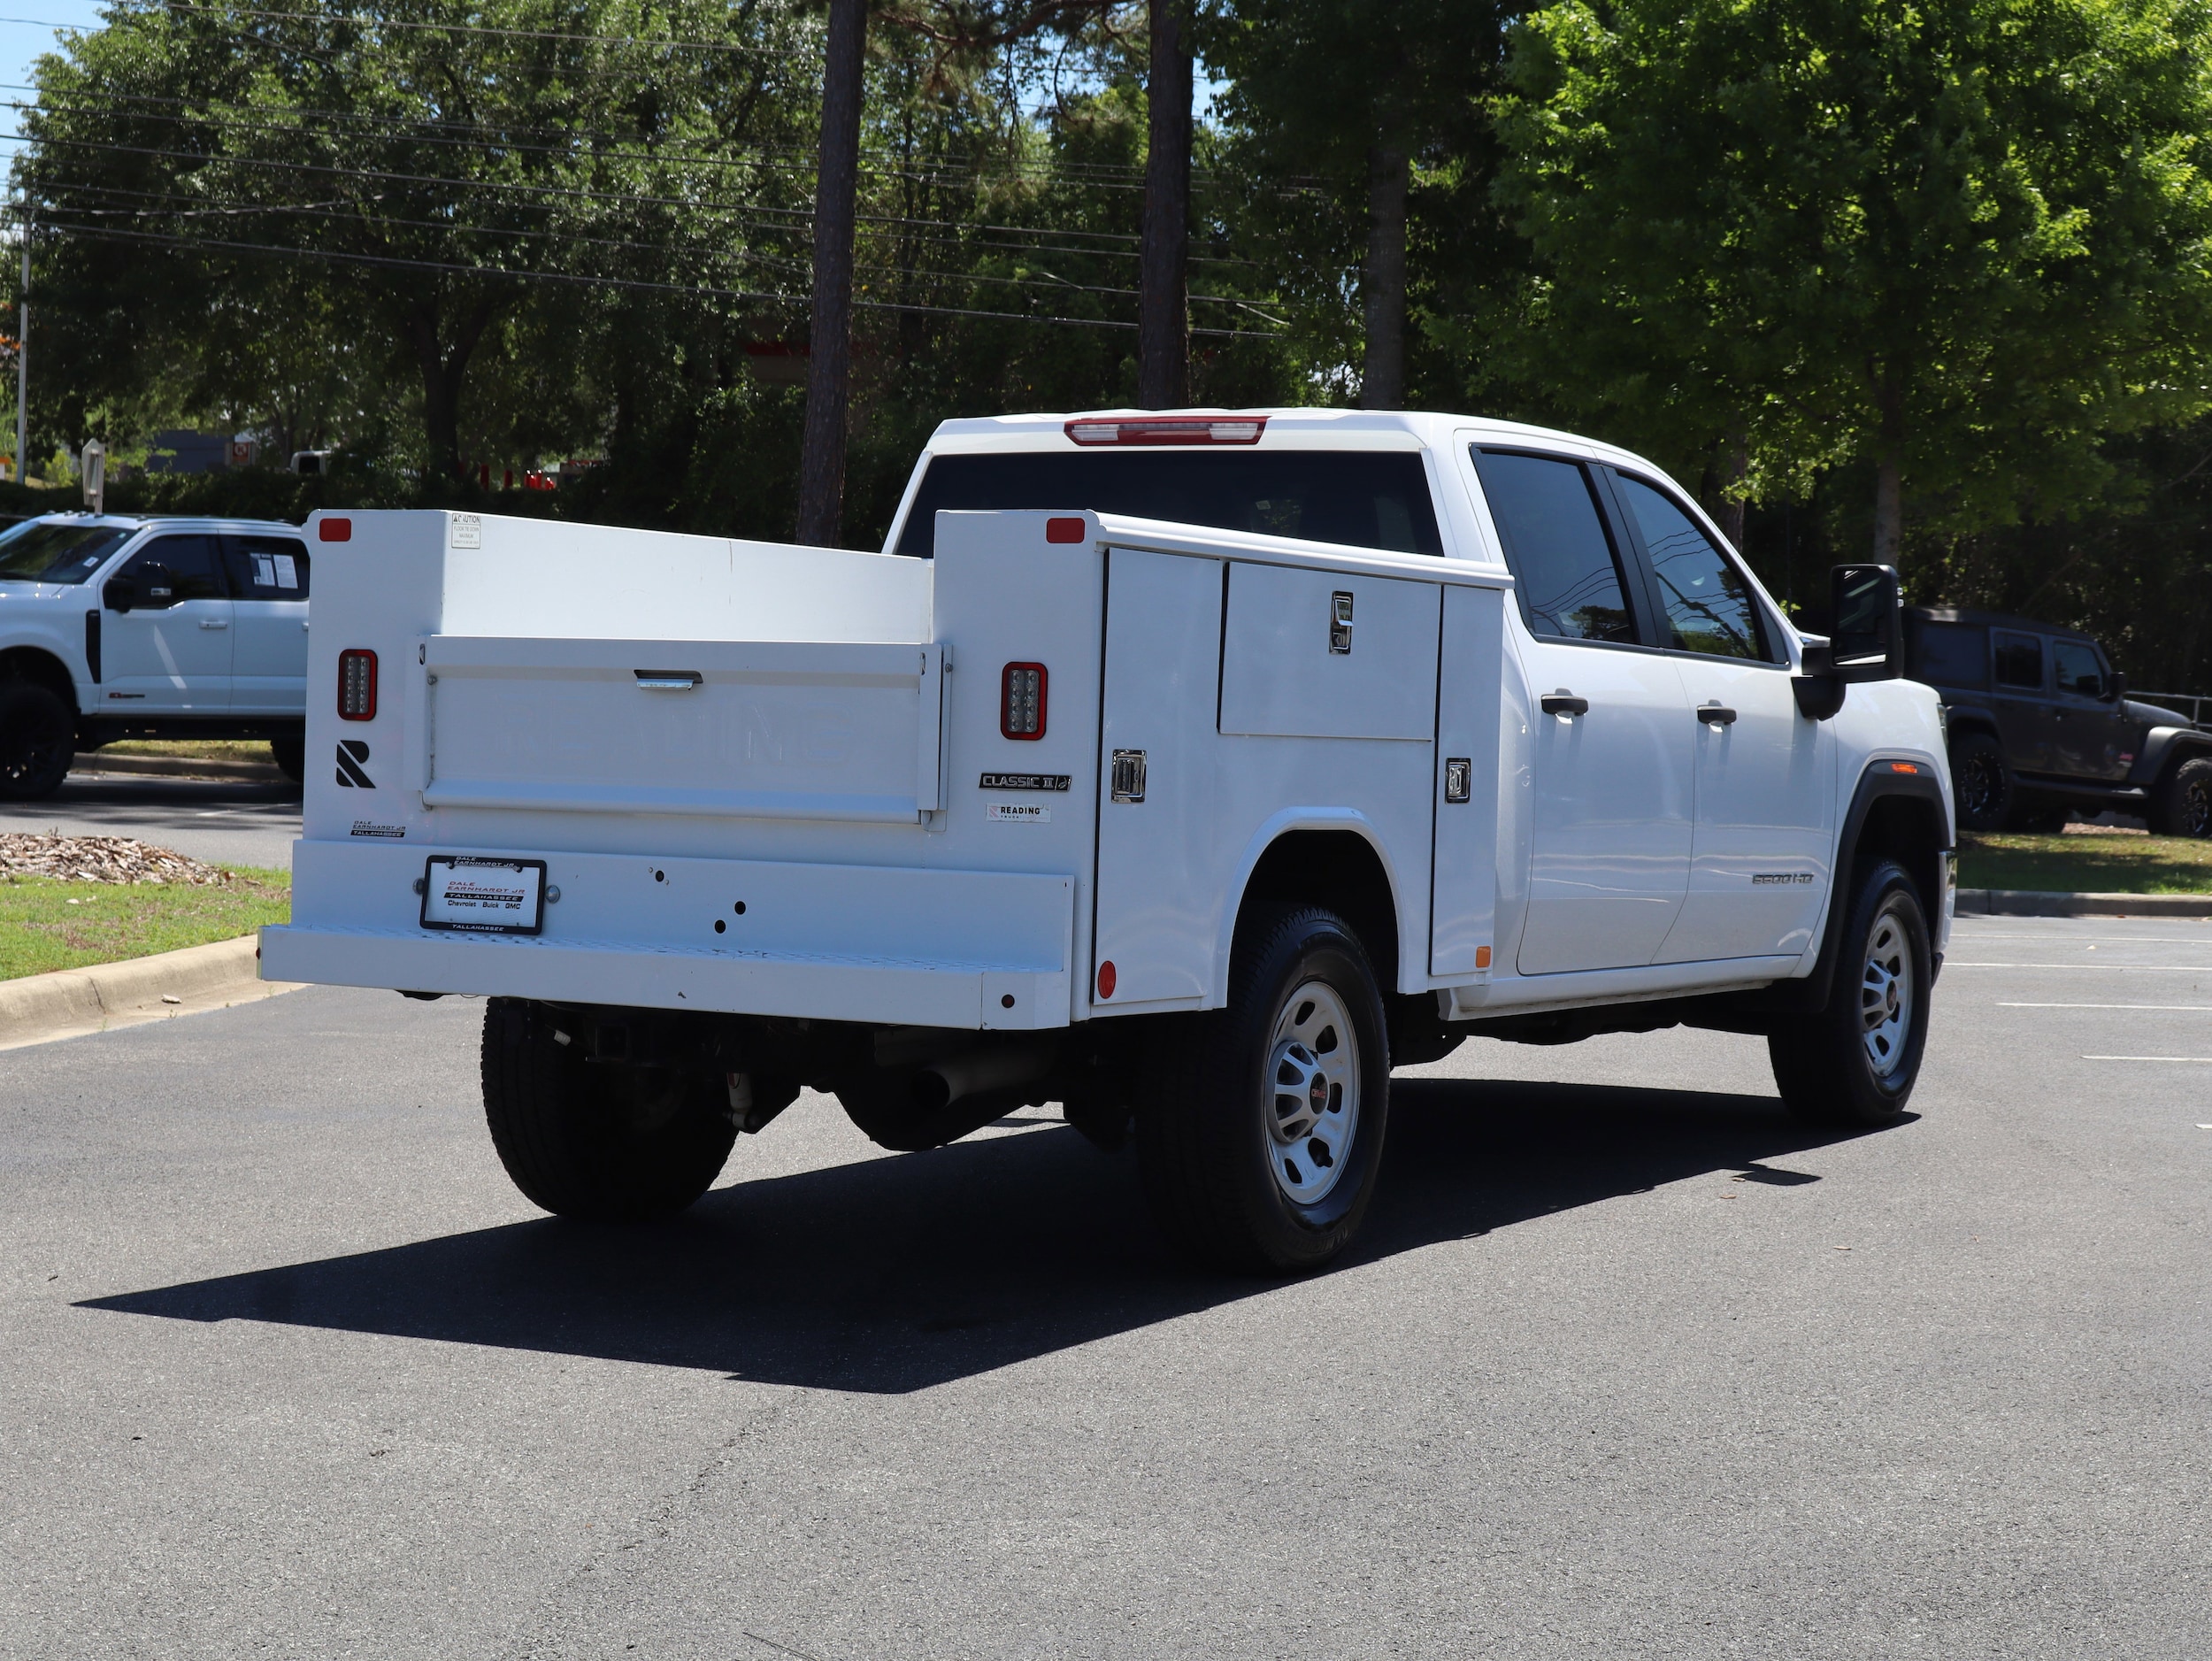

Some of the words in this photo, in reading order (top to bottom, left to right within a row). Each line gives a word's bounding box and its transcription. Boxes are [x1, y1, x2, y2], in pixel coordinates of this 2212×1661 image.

[982, 775, 1040, 788] CLASSIC
[1001, 806, 1041, 815] READING
[449, 893, 519, 902] TALLAHASSEE
[452, 923, 504, 932] TALLAHASSEE
